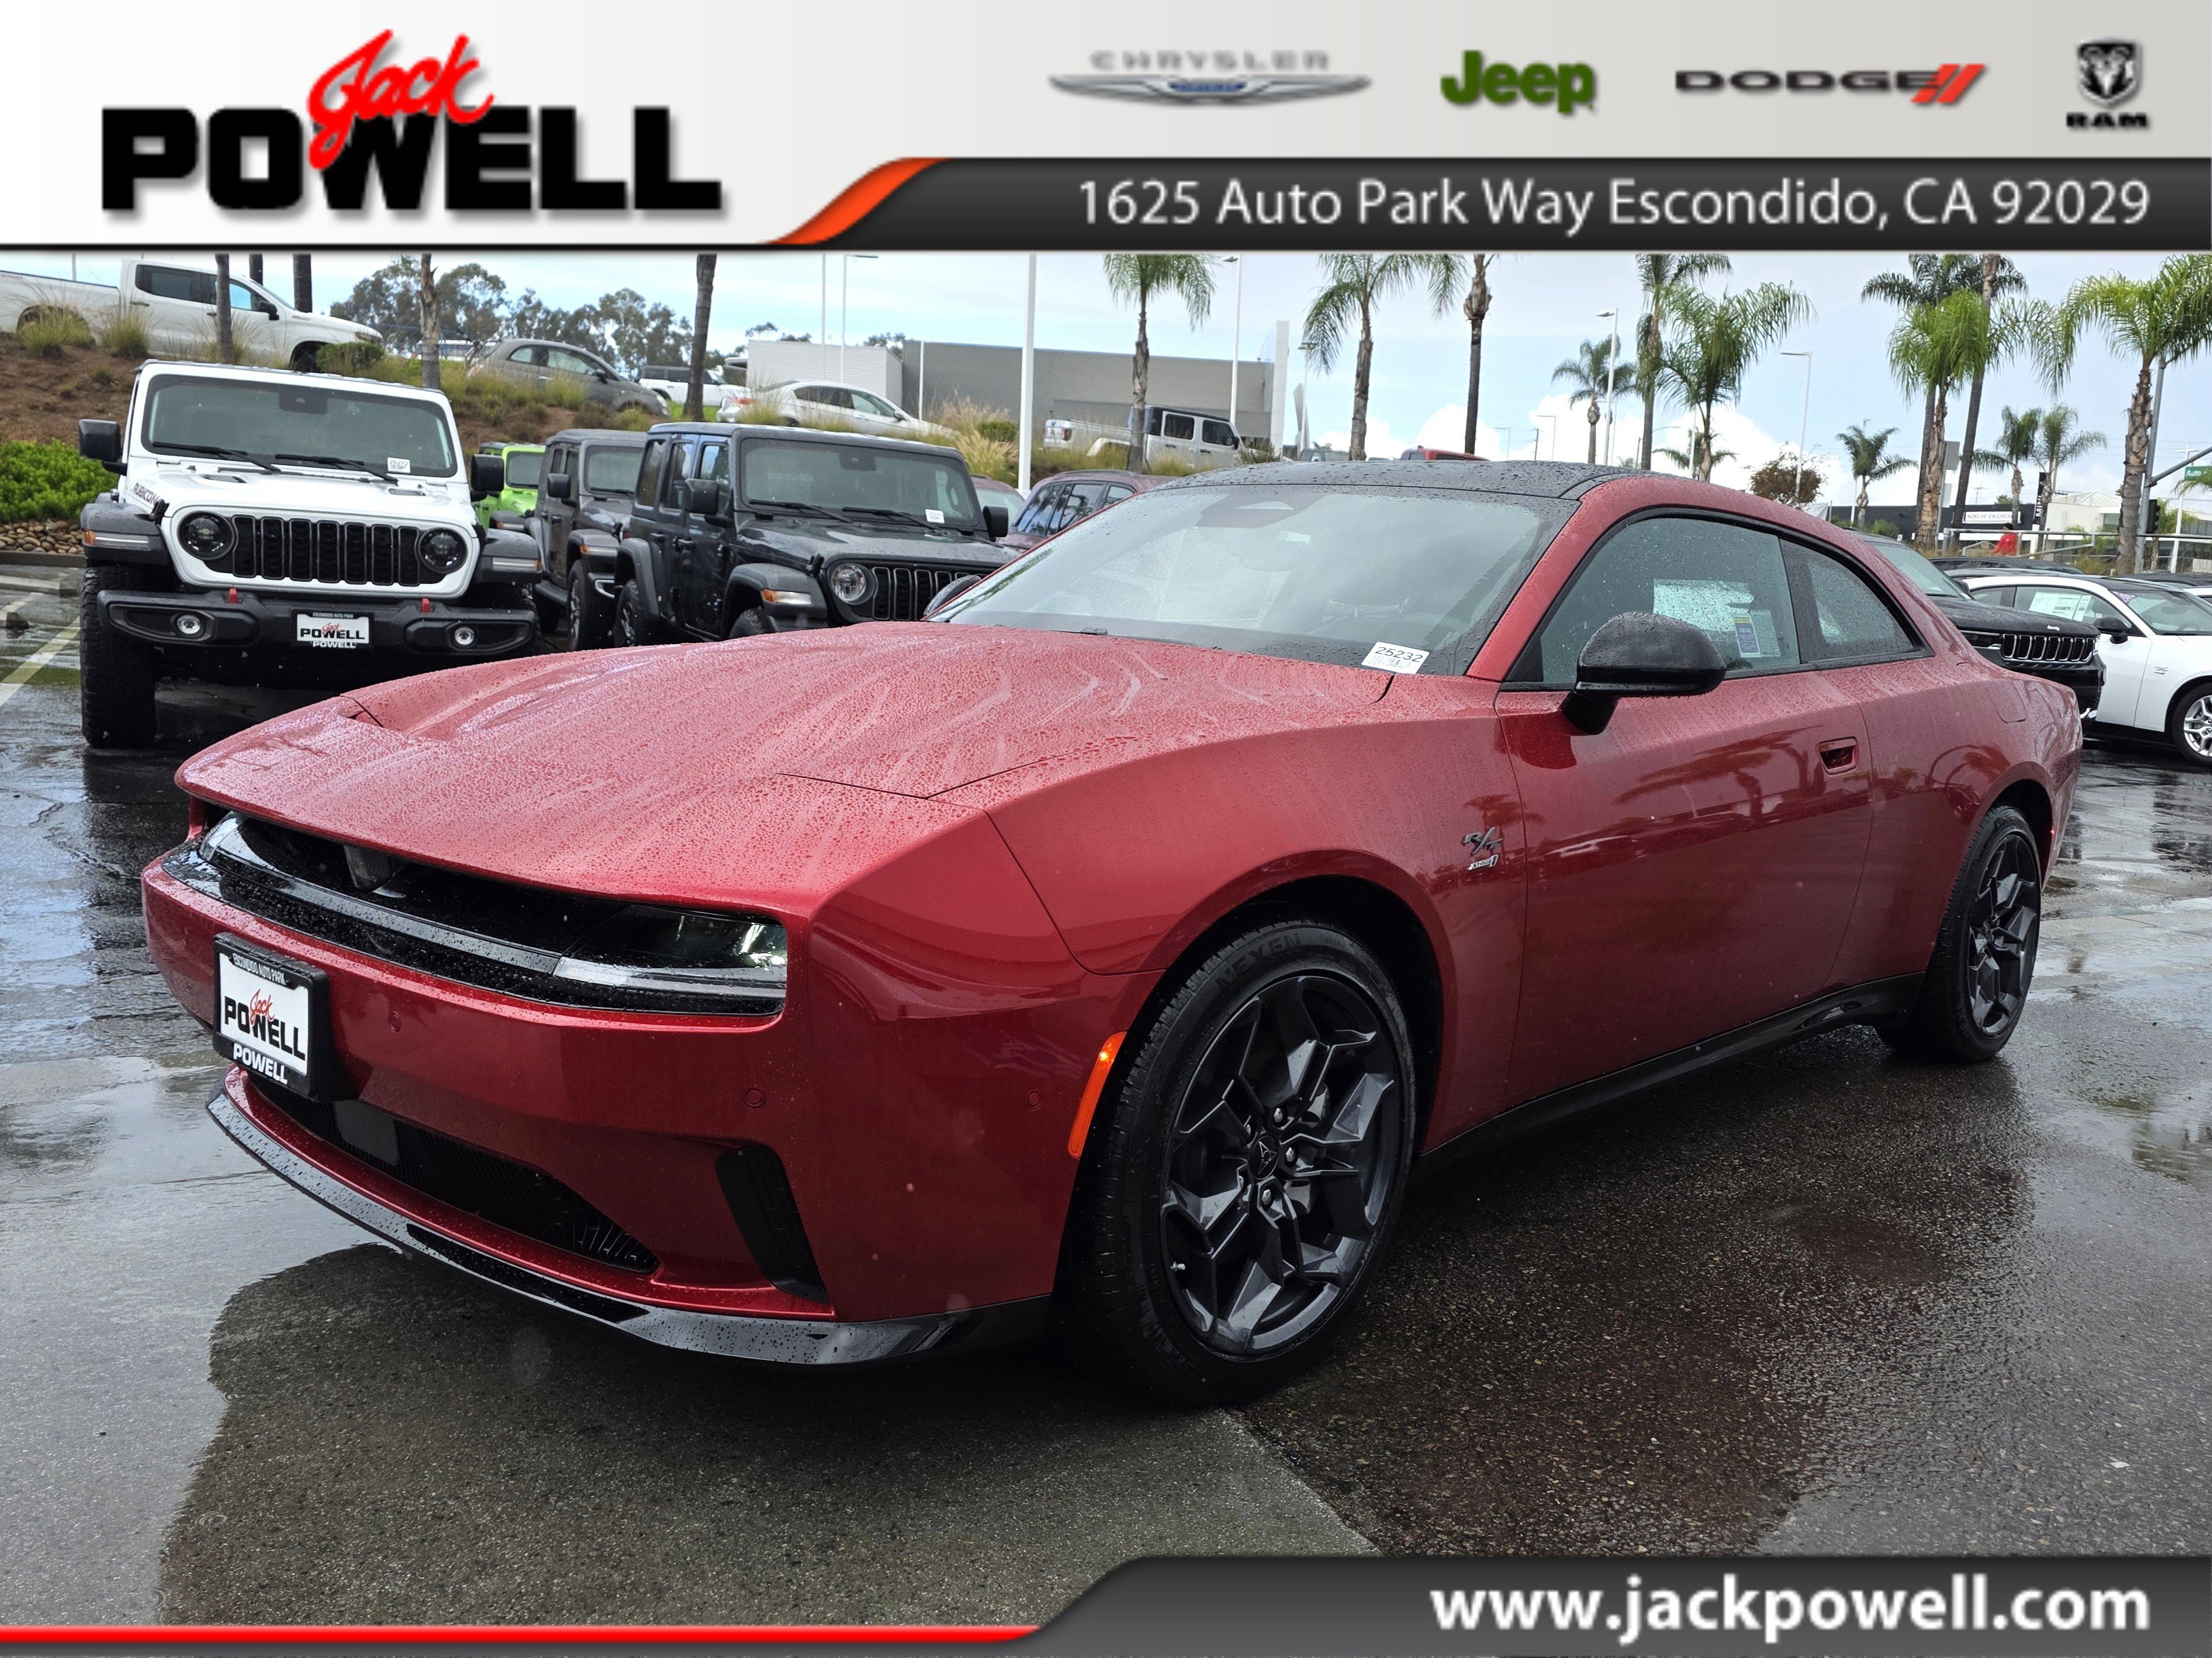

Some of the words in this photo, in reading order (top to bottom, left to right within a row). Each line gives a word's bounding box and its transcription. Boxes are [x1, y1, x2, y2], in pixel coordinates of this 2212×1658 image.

[300, 628, 365, 640] POWELL
[312, 641, 357, 649] POWELL
[1375, 646, 1423, 663] 25232
[232, 953, 259, 974] ESCONDIDO
[259, 963, 271, 980] AUTO
[271, 968, 286, 985] PARK
[1216, 933, 1302, 989] NEXEN
[250, 989, 275, 1026] Jack
[225, 996, 306, 1061] POWELL
[234, 1043, 288, 1085] POWELL
